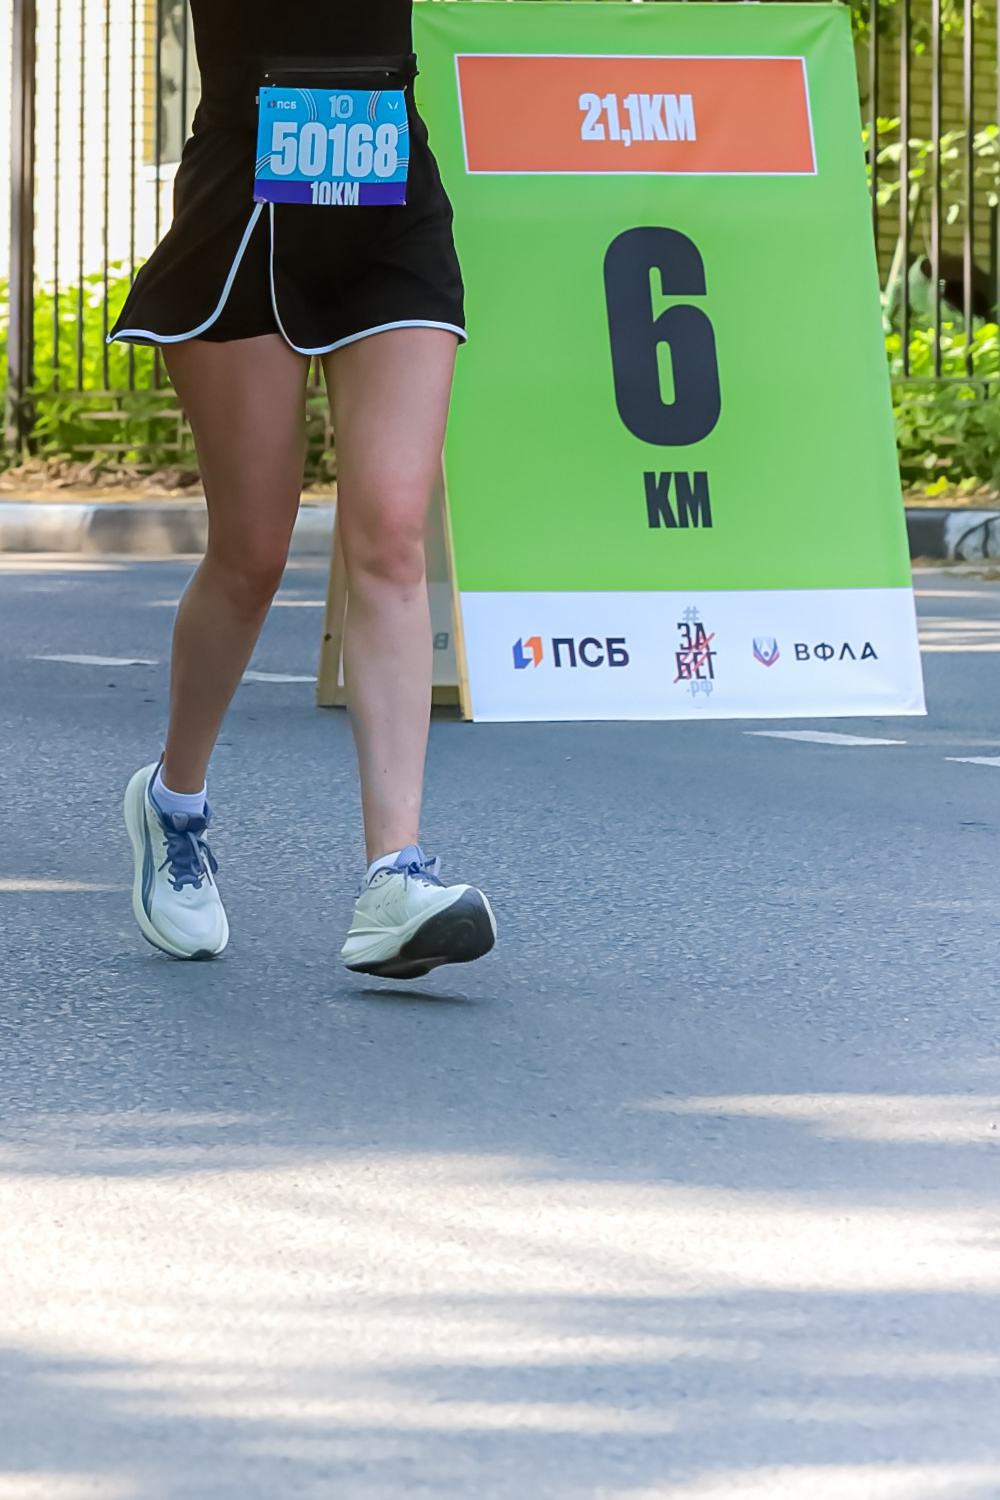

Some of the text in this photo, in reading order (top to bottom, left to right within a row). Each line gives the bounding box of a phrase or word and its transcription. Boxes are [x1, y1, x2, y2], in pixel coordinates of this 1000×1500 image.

[277, 100, 297, 110] ПСБ
[270, 121, 399, 178] 50168
[602, 225, 722, 447] 6
[552, 637, 630, 668] ПСБ
[794, 641, 879, 661] ВФЛА
